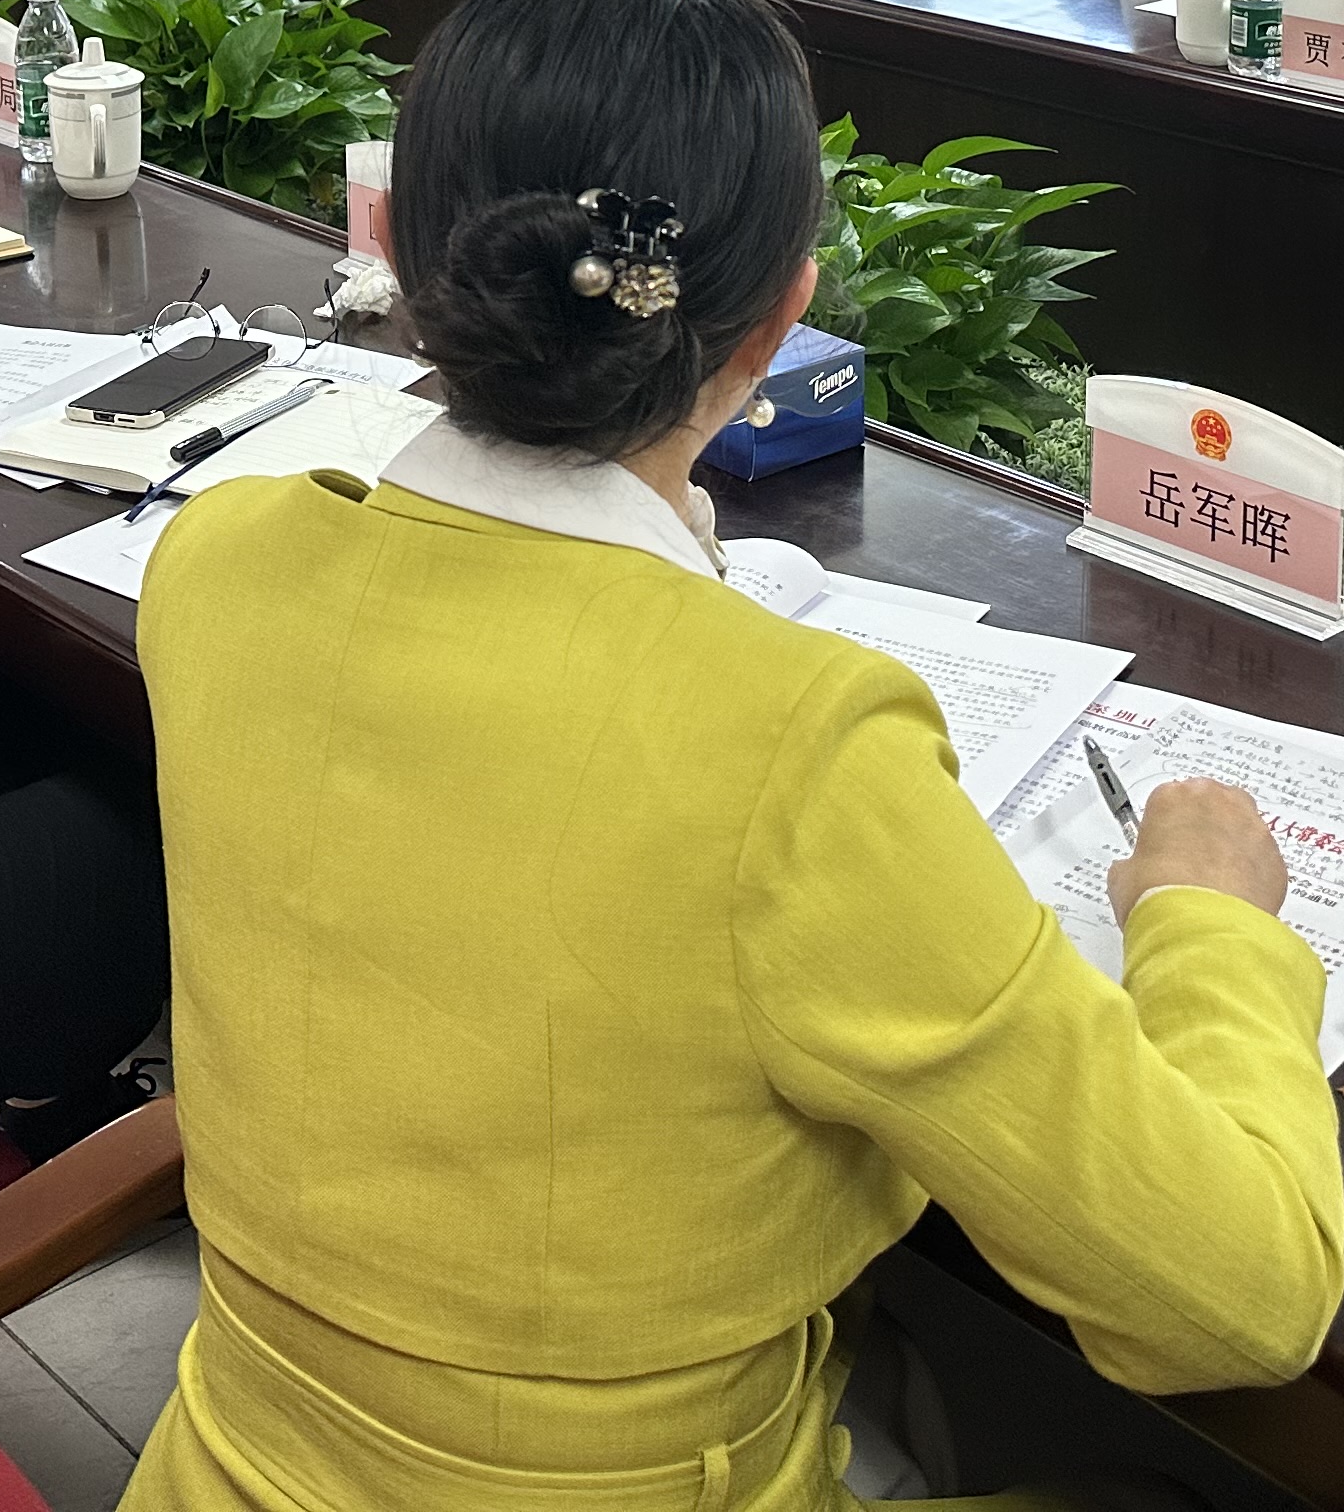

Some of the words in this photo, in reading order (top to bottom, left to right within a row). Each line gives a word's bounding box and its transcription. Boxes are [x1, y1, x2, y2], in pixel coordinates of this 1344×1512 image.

[808, 364, 858, 403] Tempo
[1138, 468, 1292, 564] 岳军晖
